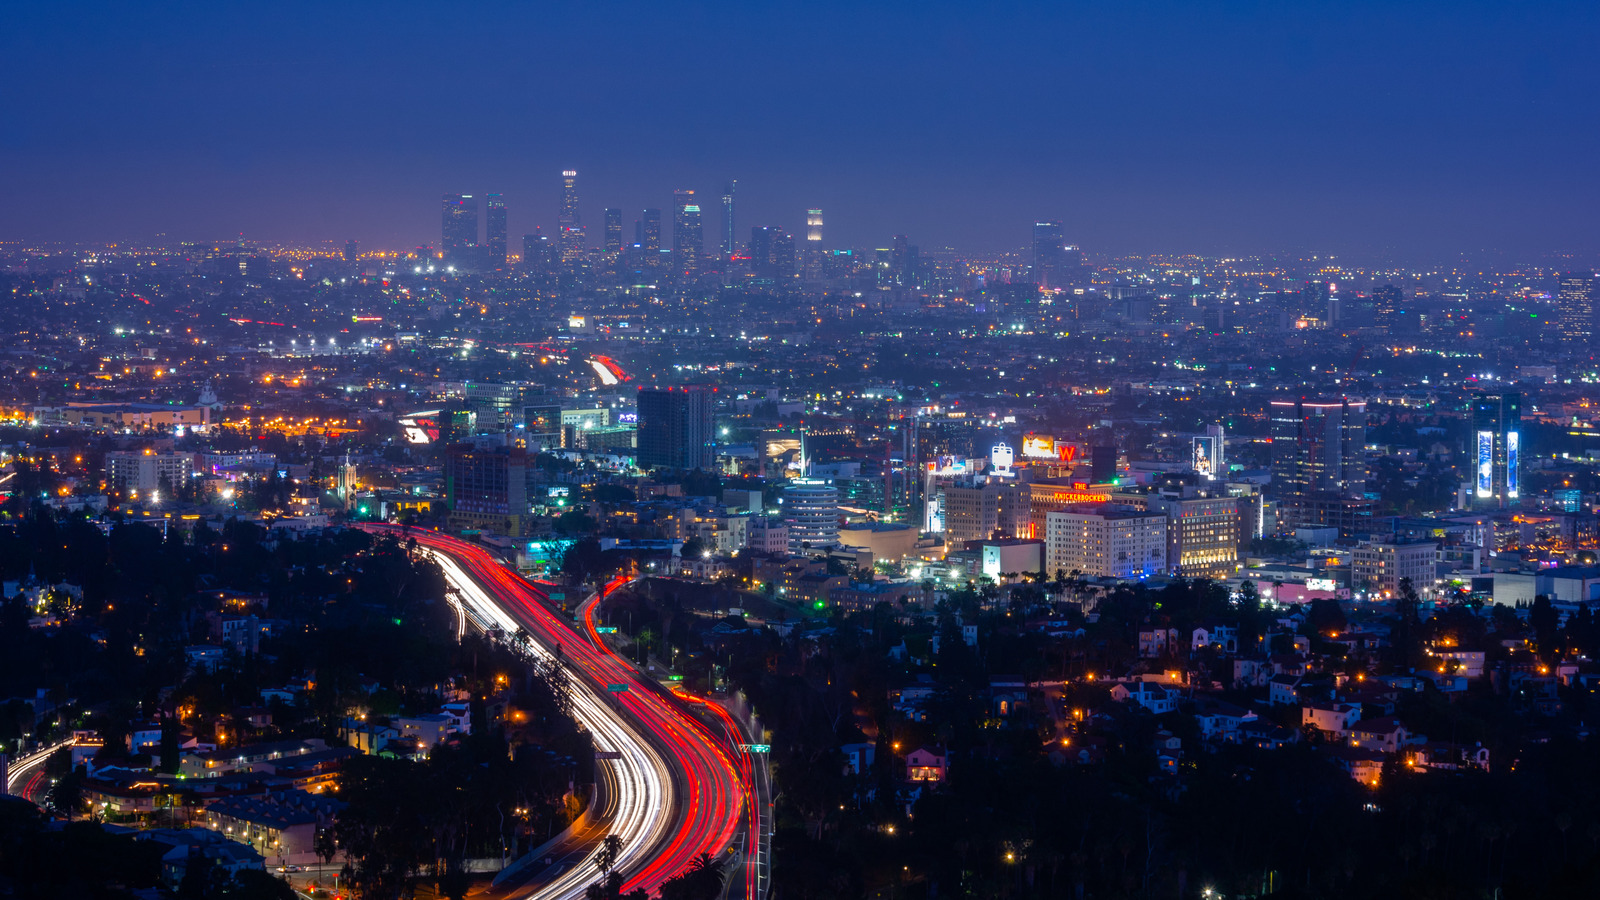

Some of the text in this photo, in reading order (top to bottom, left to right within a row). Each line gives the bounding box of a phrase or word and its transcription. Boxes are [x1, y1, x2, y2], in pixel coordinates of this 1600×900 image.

[1058, 446, 1075, 462] W
[928, 463, 935, 471] W
[1074, 482, 1087, 490] THE
[1054, 492, 1106, 502] KNICKERBOCKER
